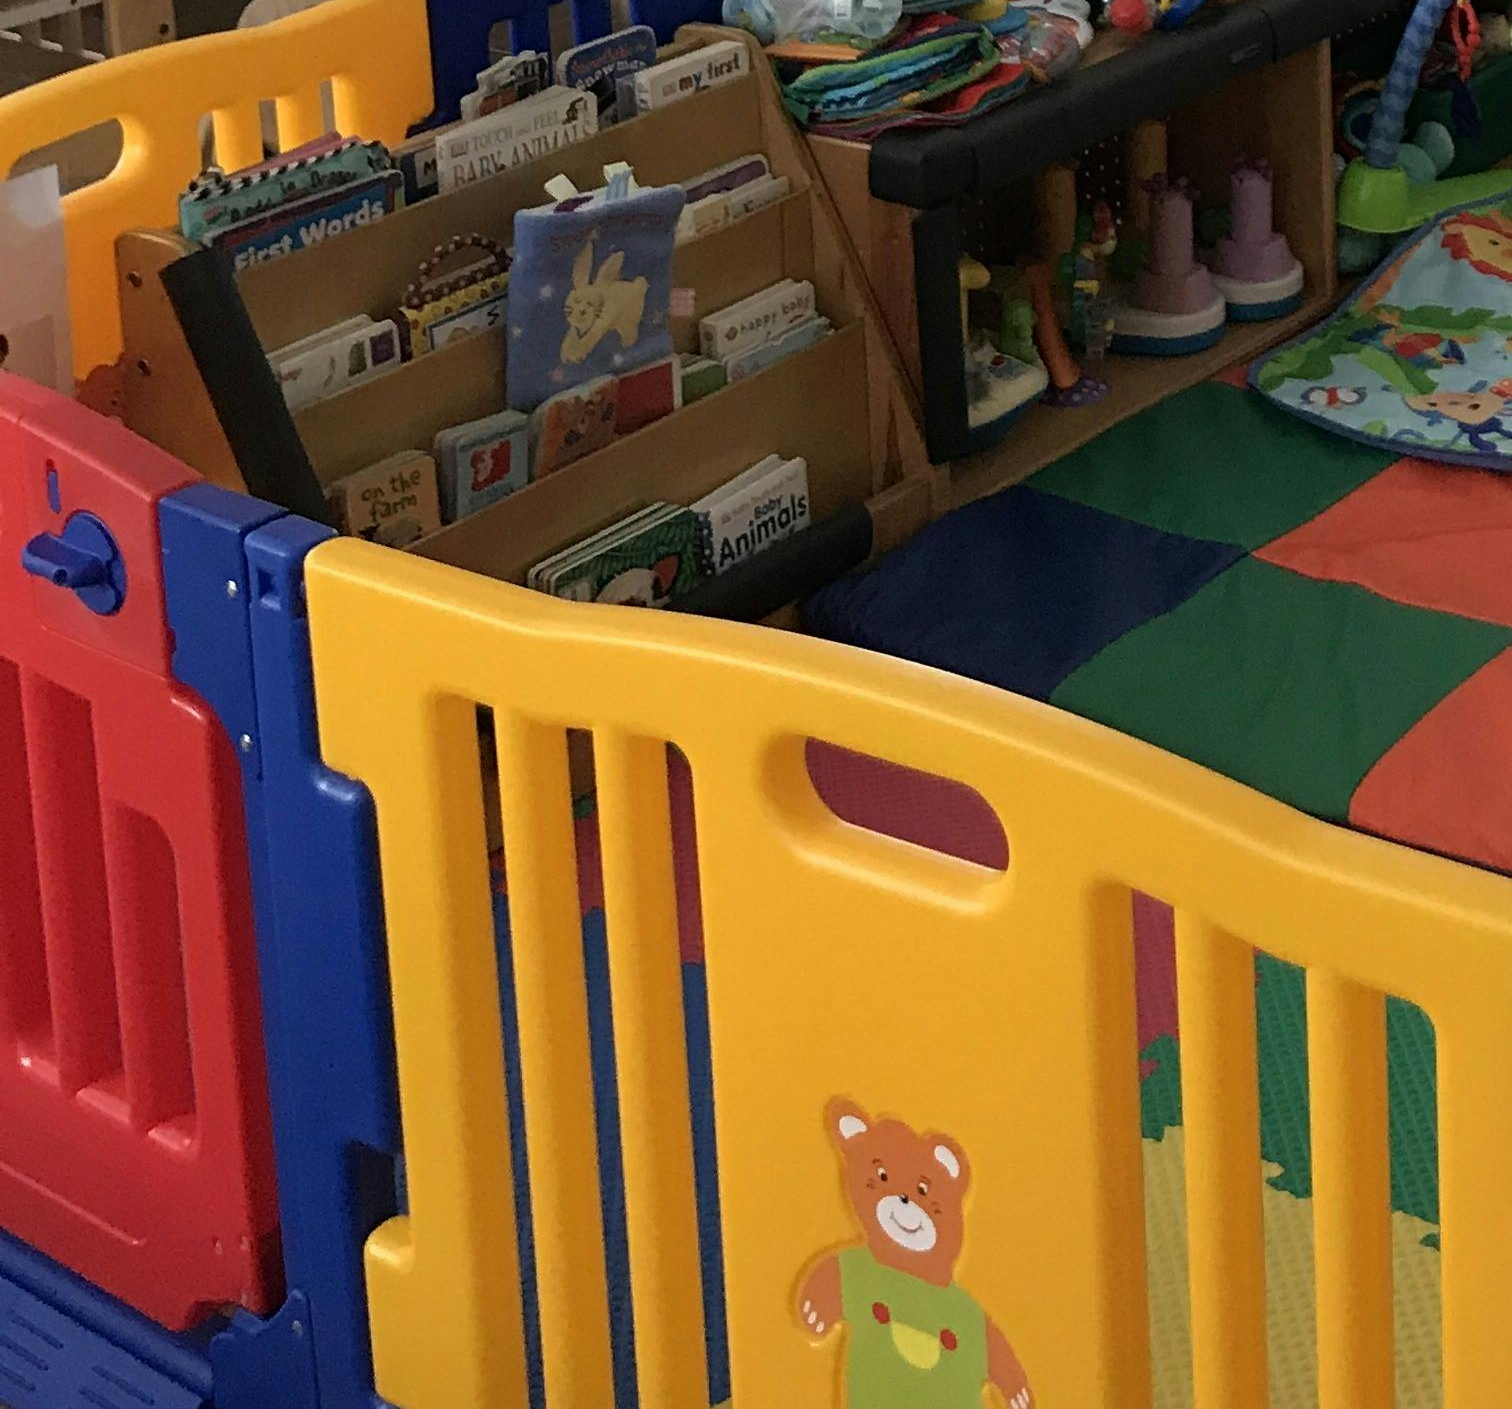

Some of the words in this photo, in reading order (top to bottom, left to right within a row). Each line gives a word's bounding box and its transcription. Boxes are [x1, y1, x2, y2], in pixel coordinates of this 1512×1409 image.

[678, 71, 703, 91] my
[706, 53, 741, 80] first
[467, 125, 514, 151] TOUCH
[533, 109, 560, 131] FEEL
[234, 234, 294, 270] First
[299, 198, 385, 246] Words
[739, 311, 777, 335] happy
[781, 294, 811, 315] baby
[361, 485, 384, 502] on
[389, 469, 421, 494] the
[369, 493, 418, 523] farm
[753, 494, 783, 520] Baby
[719, 493, 807, 567] Animals
